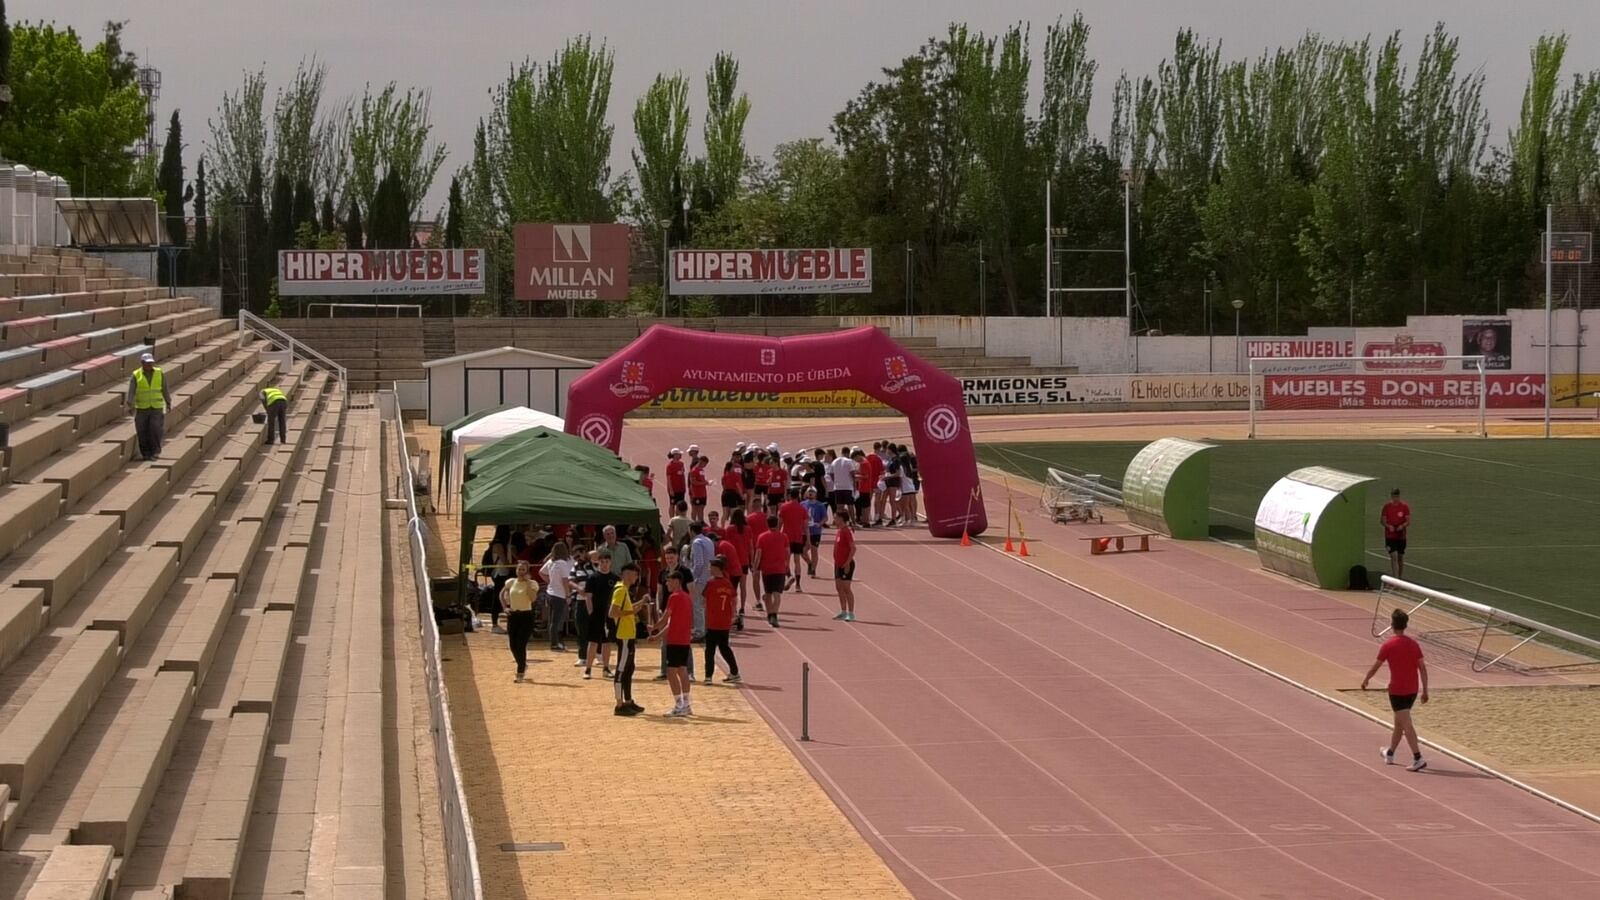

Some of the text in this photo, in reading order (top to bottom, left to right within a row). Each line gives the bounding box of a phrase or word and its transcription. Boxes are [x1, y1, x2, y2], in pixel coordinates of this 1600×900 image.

[530, 267, 614, 287] MILLAN
[547, 289, 598, 300] MUEBLES
[682, 367, 852, 383] AYUNTAMIENTO DE ÚBEDA
[1146, 382, 1172, 399] Hotel
[1211, 383, 1224, 398] de
[1272, 376, 1546, 396] MUEBLES DON REBAJÓN
[782, 394, 796, 404] en
[799, 391, 847, 405] muebles
[850, 391, 858, 407] y
[1046, 391, 1085, 403] S.L.
[720, 595, 727, 611] 7
